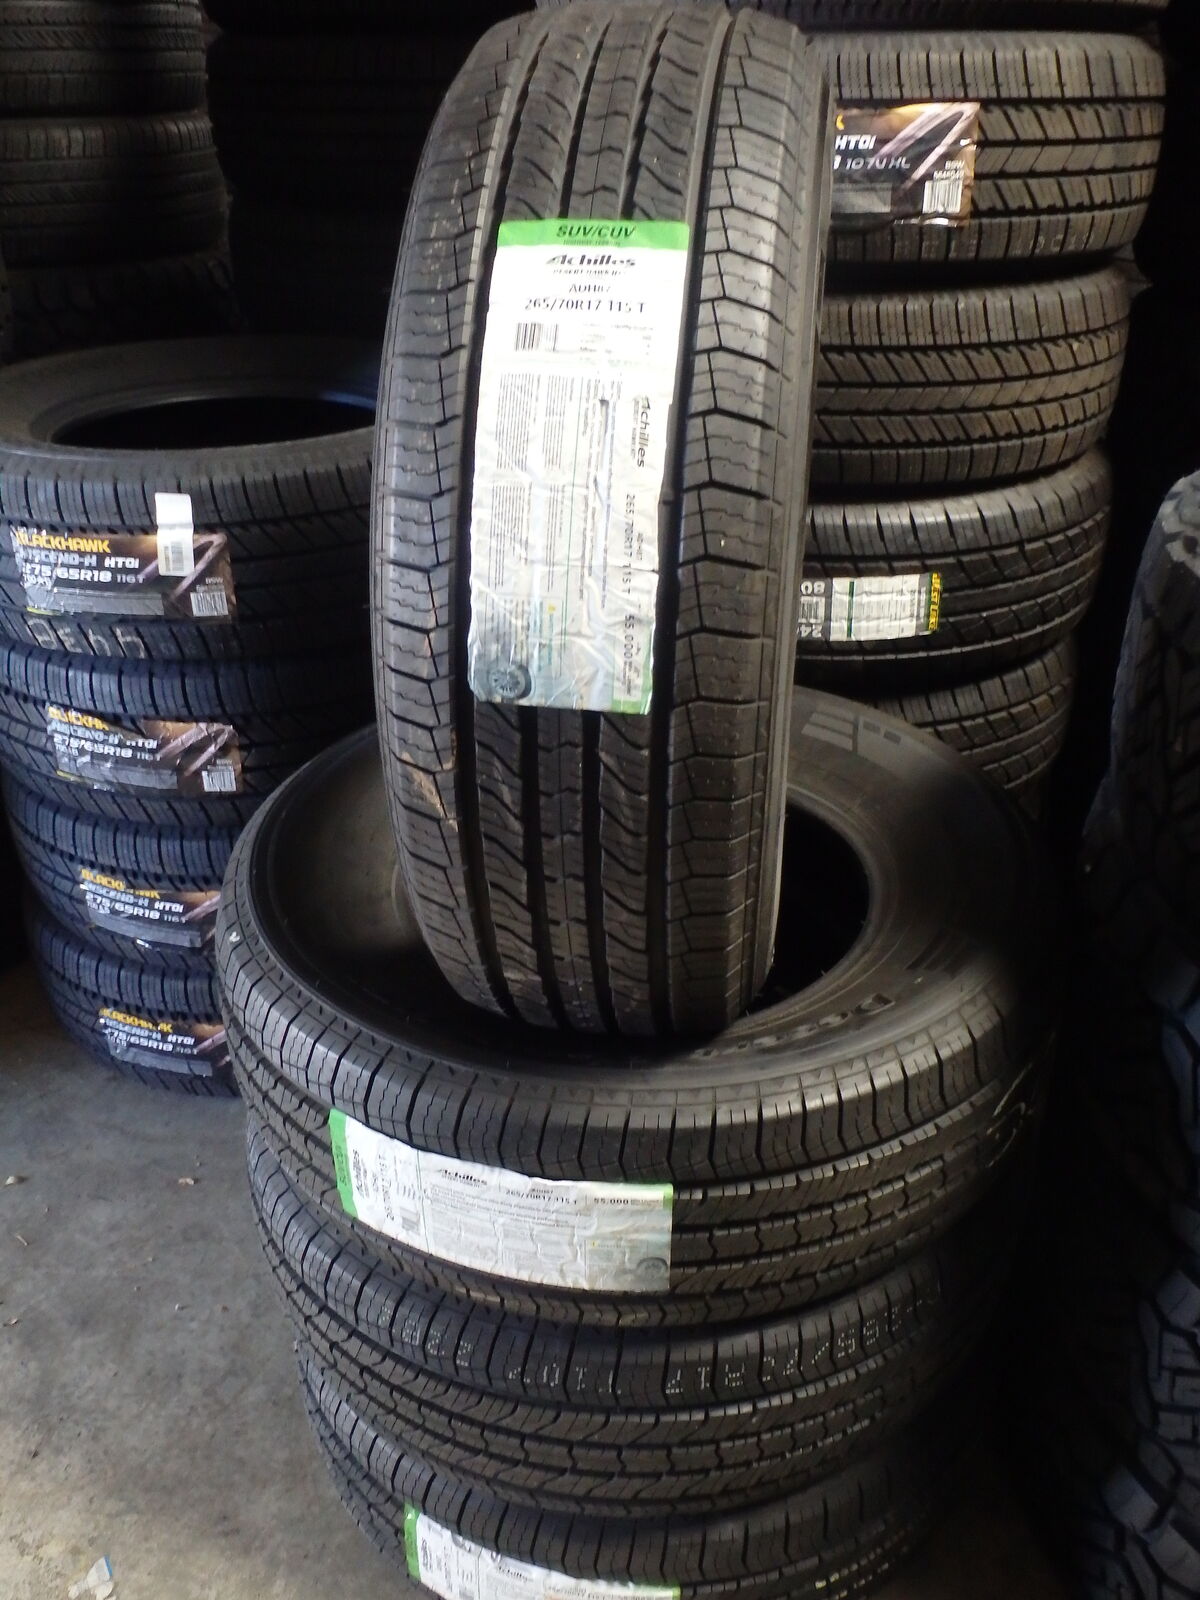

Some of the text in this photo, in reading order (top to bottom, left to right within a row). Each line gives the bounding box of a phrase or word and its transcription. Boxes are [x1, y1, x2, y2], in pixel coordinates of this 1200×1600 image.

[556, 224, 636, 238] SUV/CUV
[546, 254, 636, 267] Achilles
[524, 297, 645, 313] 265/70R17 115 T
[636, 395, 651, 467] Achilles
